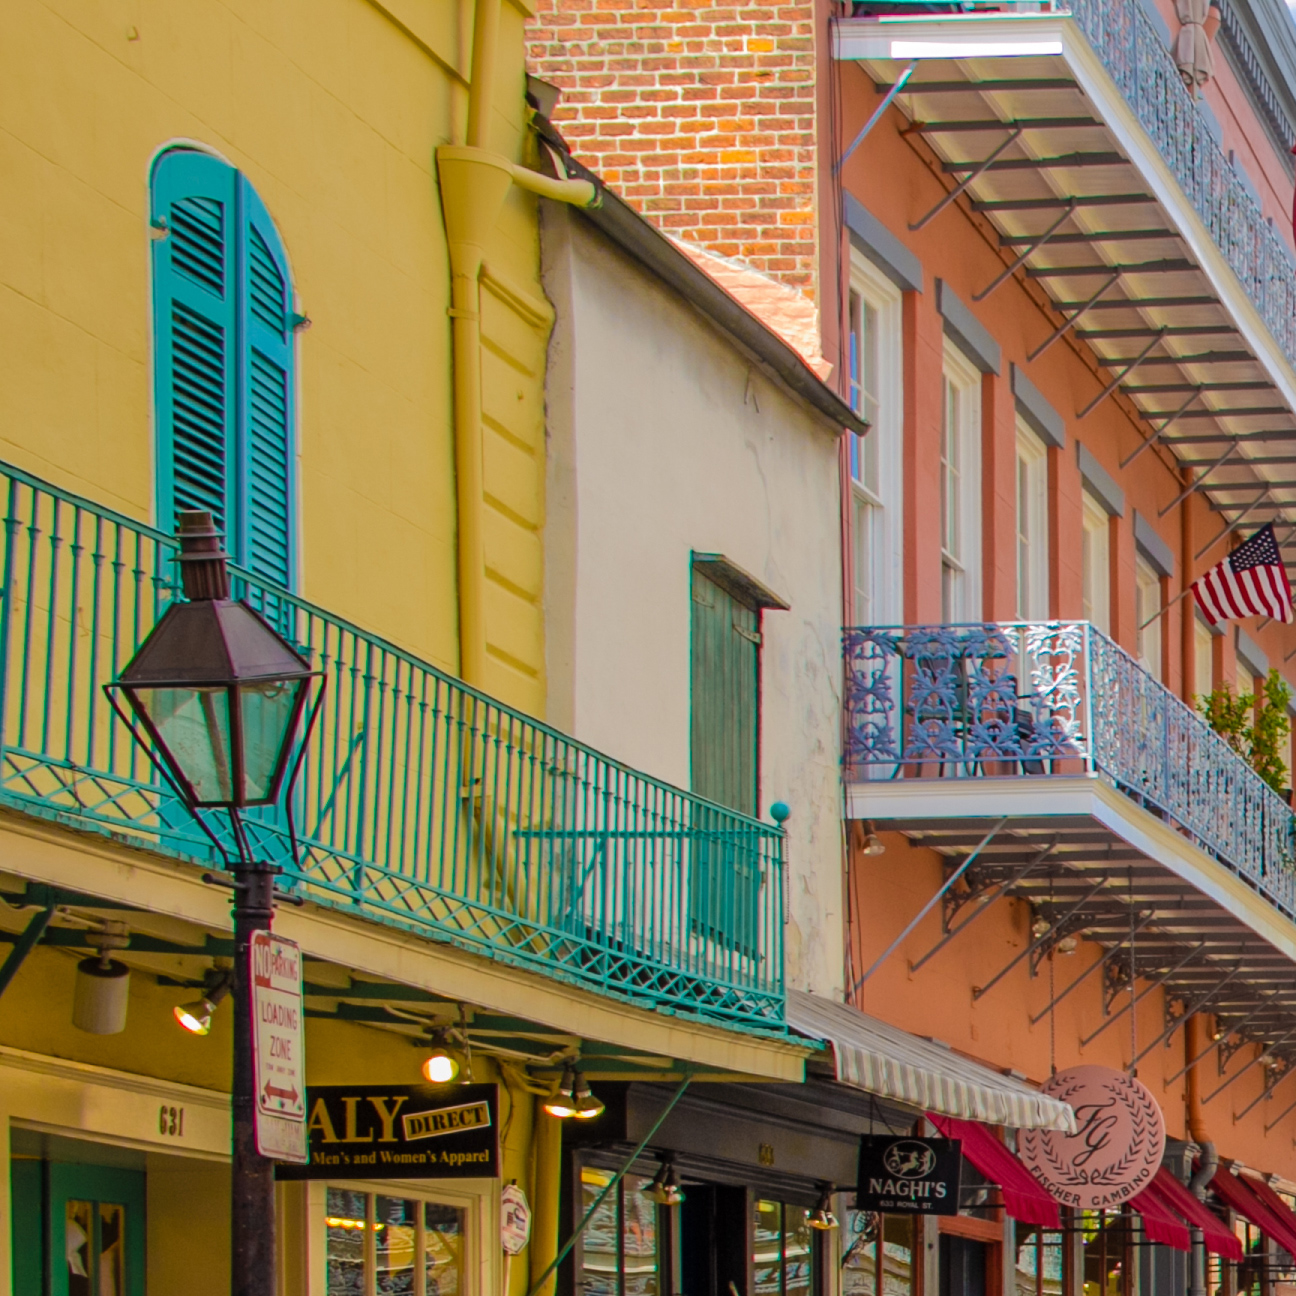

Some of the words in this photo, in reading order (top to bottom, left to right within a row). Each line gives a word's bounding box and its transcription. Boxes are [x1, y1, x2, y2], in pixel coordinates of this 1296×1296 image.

[255, 943, 271, 977] NO
[271, 953, 298, 981] PARKING
[261, 1000, 298, 1031] LOADING
[269, 1035, 292, 1061] ZONE
[159, 1105, 184, 1137] 631
[308, 1096, 409, 1143] ALY
[408, 1106, 485, 1136] DIRECT
[313, 1151, 350, 1164] Men's
[353, 1151, 377, 1164] and
[380, 1150, 437, 1164] Women's
[439, 1149, 490, 1166] Apparel
[868, 1178, 948, 1198] NAGHI'S
[1030, 1165, 1082, 1207] FISCHER
[1091, 1167, 1150, 1207] GAMBINO
